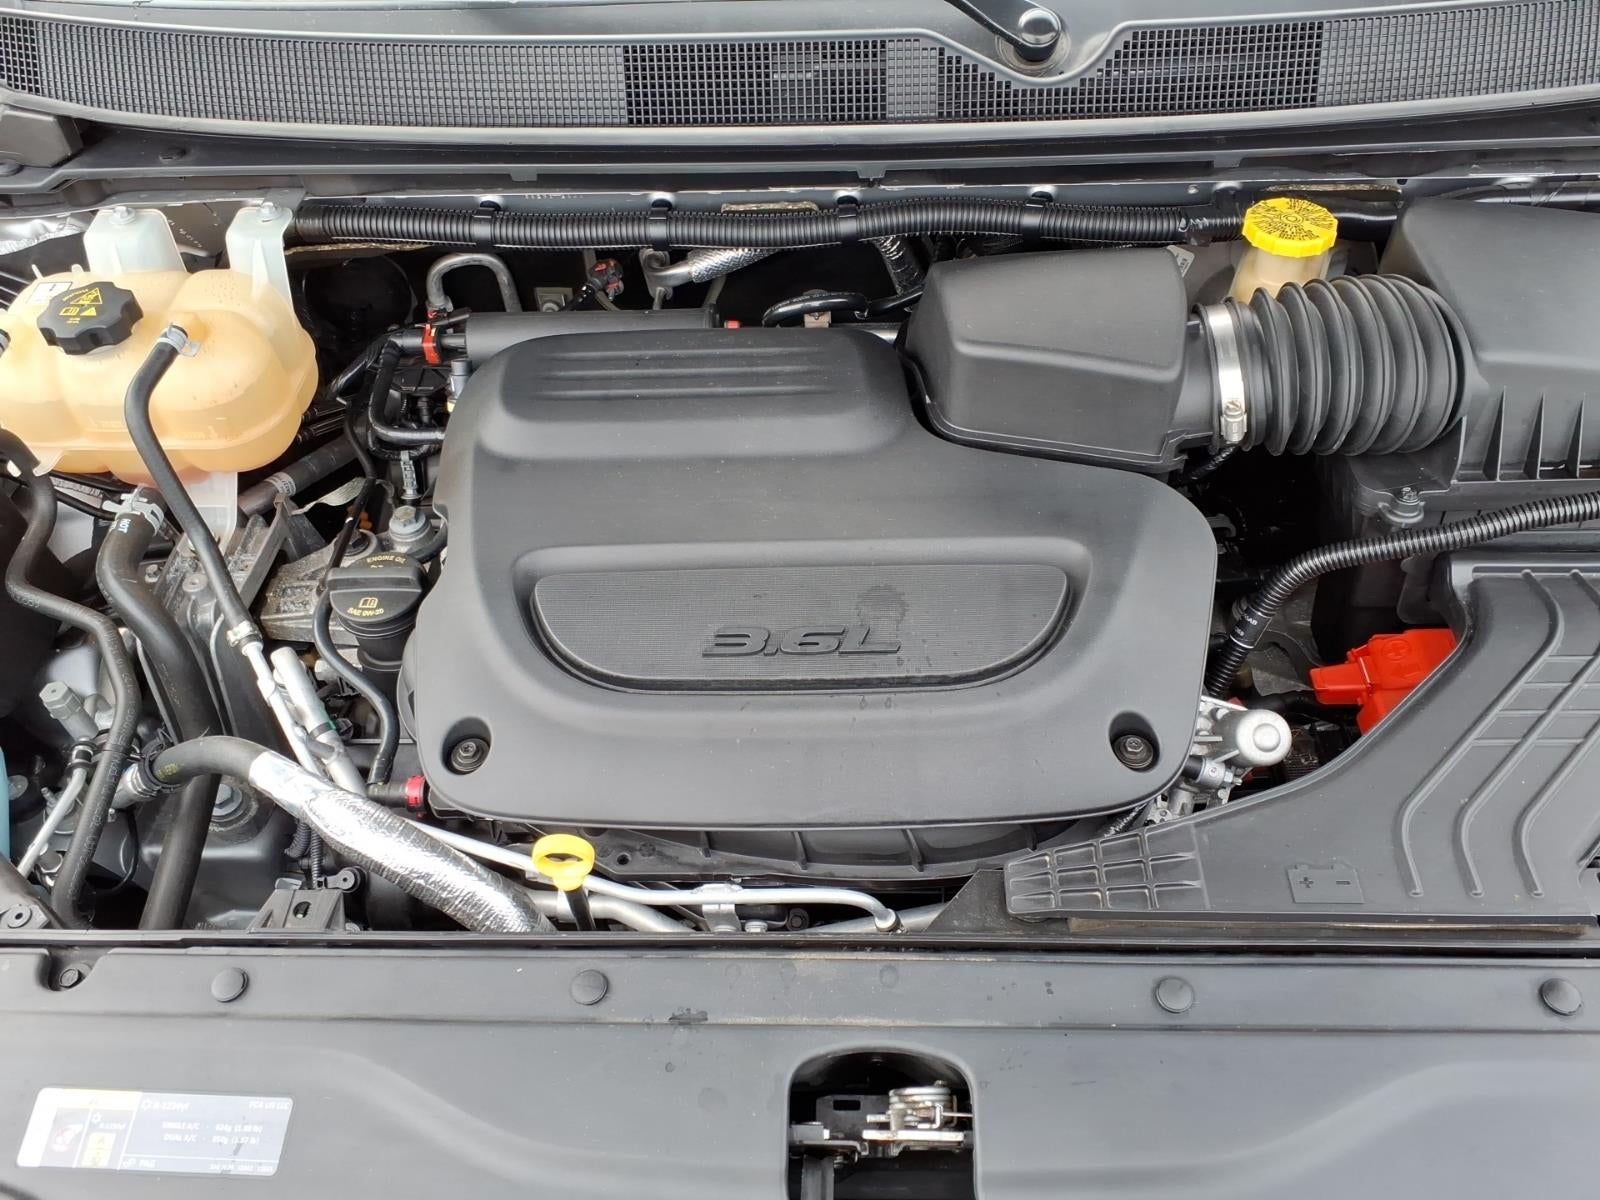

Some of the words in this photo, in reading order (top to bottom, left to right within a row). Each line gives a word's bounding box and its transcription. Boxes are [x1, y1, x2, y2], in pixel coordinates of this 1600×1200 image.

[366, 555, 395, 563] ENGINE
[395, 556, 406, 564] OIL
[347, 607, 361, 616] SAE
[362, 608, 385, 616] 0W-20
[702, 625, 901, 657] 3.6L
